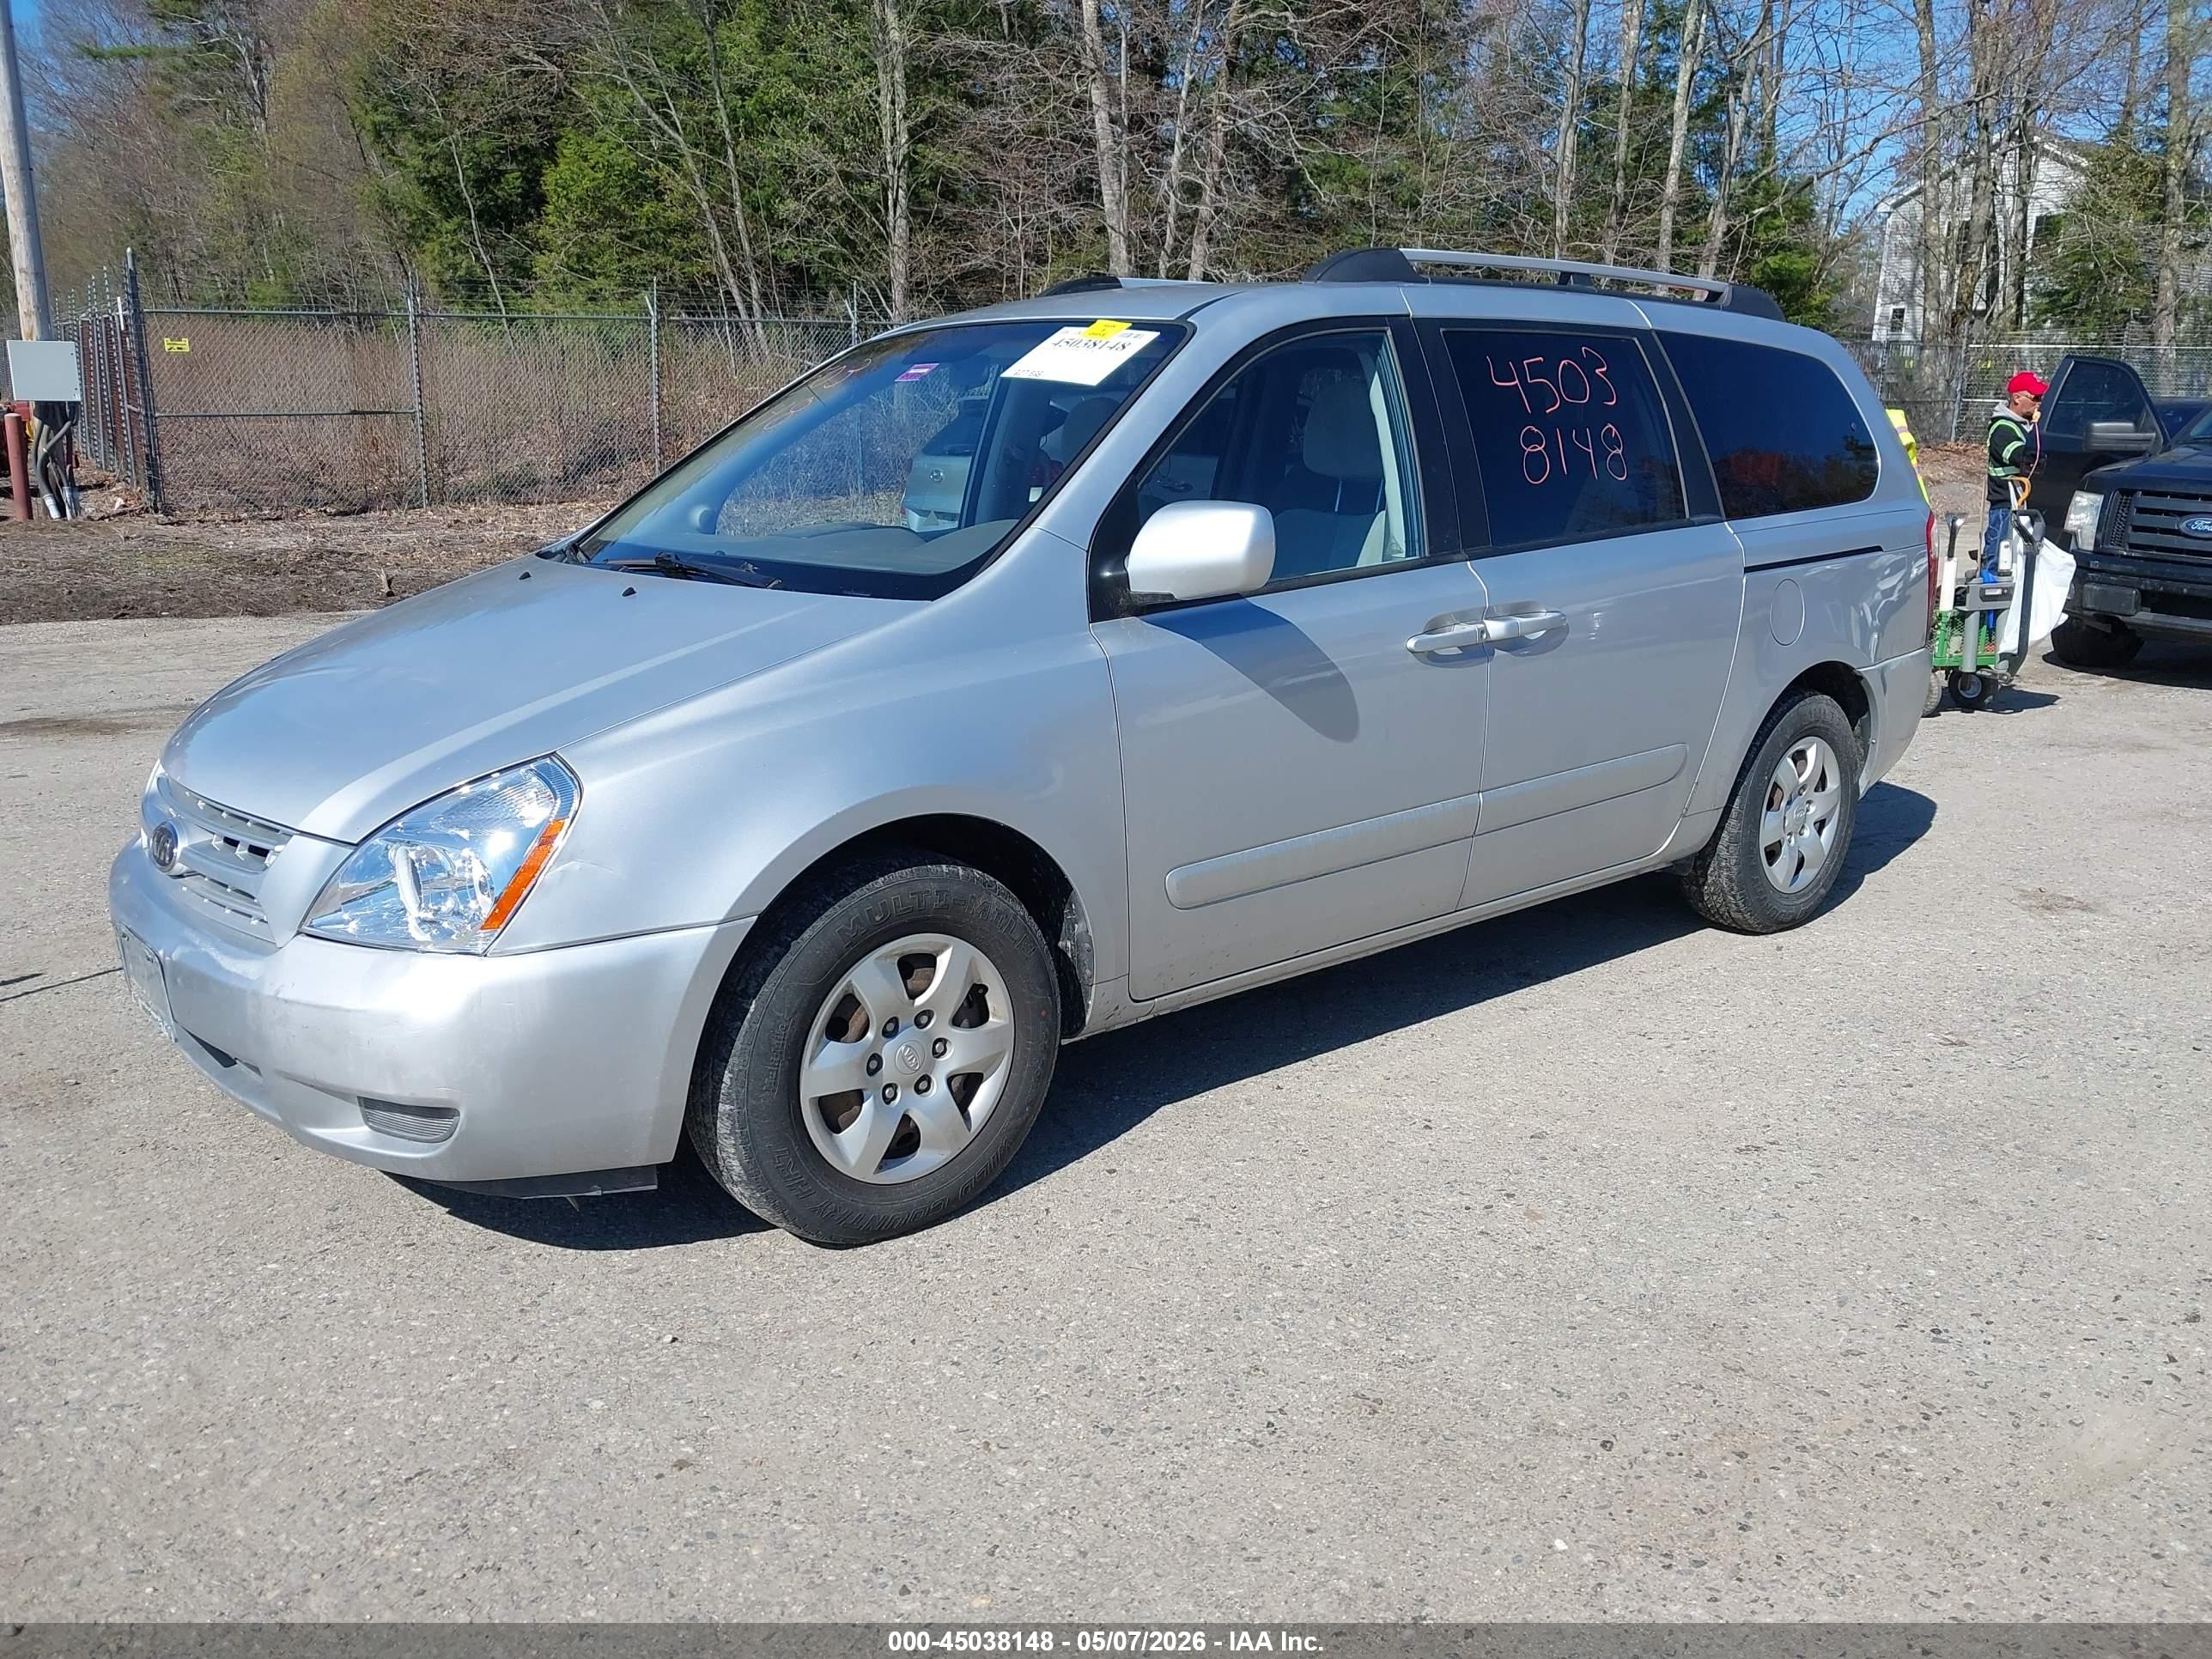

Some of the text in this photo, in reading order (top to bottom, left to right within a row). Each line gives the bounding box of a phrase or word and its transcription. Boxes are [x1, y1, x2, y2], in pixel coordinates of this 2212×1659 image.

[1051, 337, 1132, 352] 45038148
[1486, 346, 1617, 414] 4503
[1520, 422, 1628, 484] 8148
